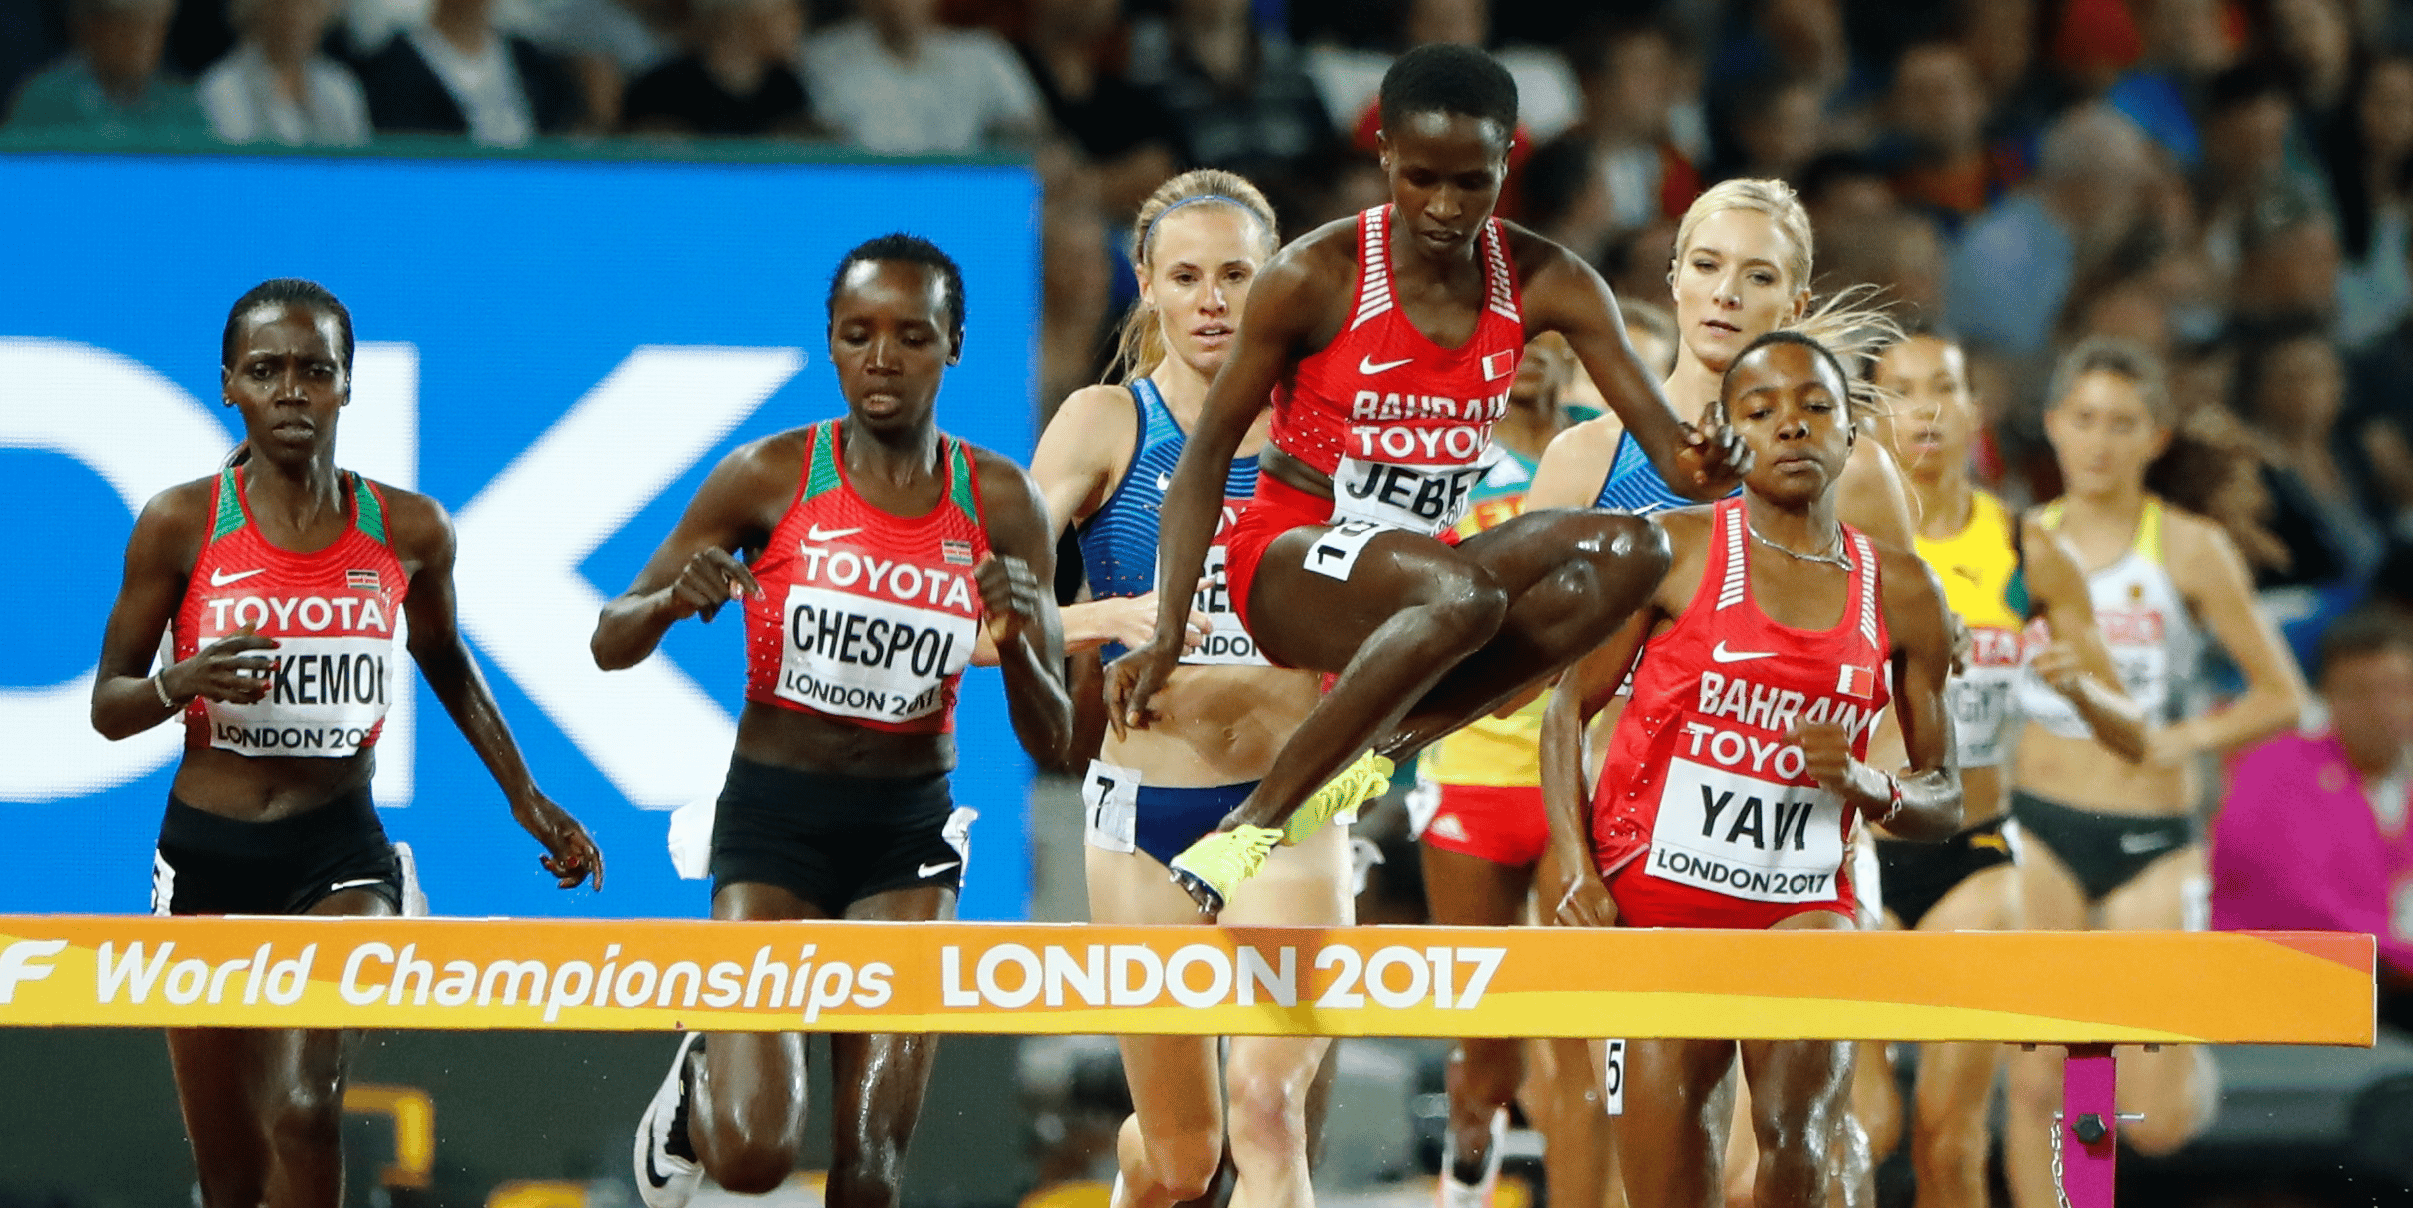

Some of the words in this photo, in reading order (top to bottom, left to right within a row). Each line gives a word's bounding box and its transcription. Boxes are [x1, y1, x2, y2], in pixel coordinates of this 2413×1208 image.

[801, 539, 973, 613] TOYOTA
[208, 595, 388, 633] TOYOTA
[792, 603, 954, 680] CHESPOL
[785, 670, 887, 712] LONDON
[217, 722, 324, 748] LONDON
[1686, 721, 1806, 780] TOYO
[1095, 775, 1115, 829] 7
[1700, 783, 1813, 851] YAVI
[1656, 847, 1771, 894] LONDON
[1773, 874, 1829, 896] 2017
[97, 940, 318, 1006] World
[340, 941, 894, 1024] Championships
[941, 943, 1298, 1008] LONDON
[1313, 945, 1508, 1010] 2017
[1608, 1042, 1622, 1096] 5
